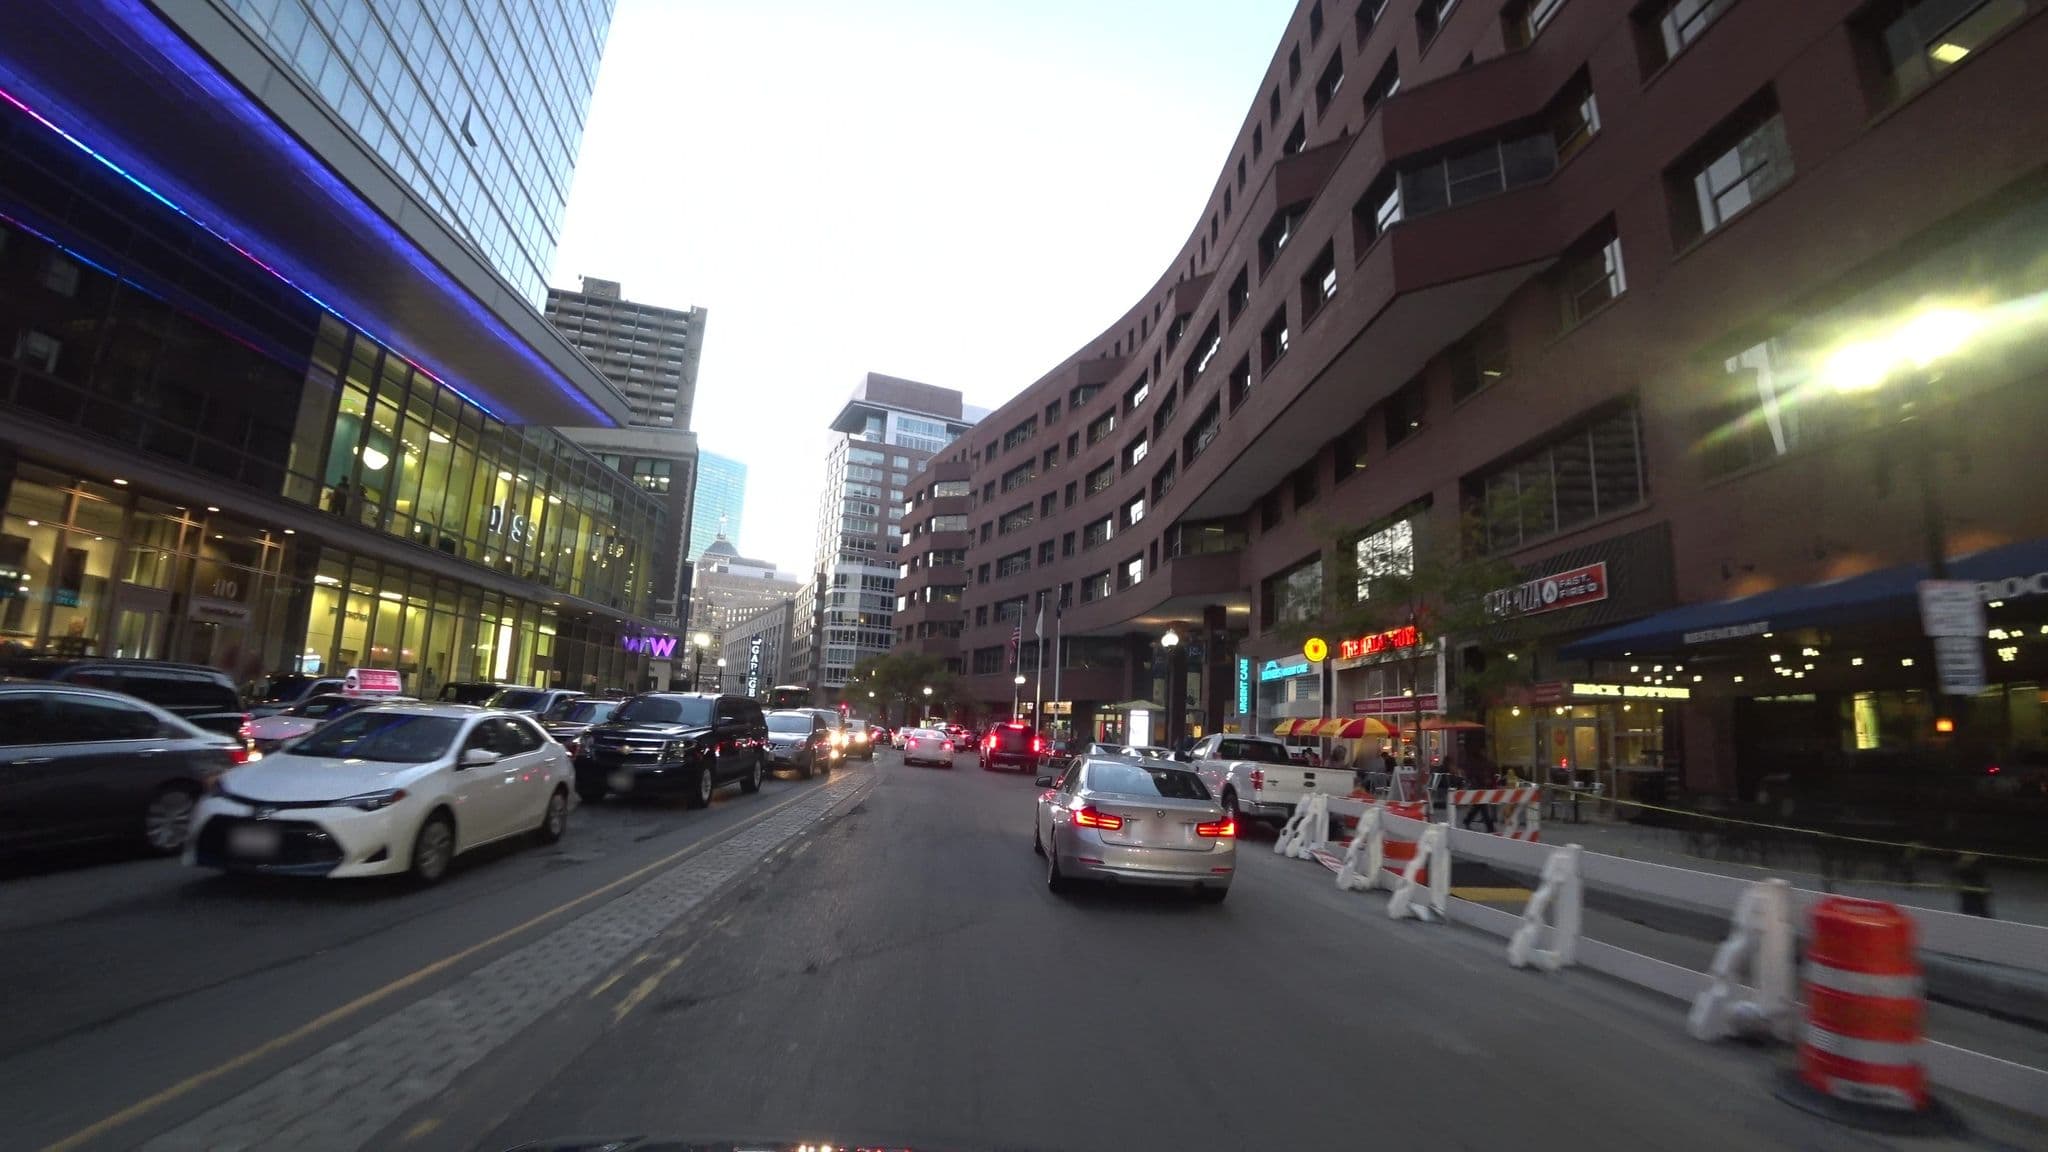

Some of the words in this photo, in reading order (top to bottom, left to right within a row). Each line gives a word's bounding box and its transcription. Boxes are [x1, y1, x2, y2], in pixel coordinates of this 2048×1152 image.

[1360, 632, 1391, 656] HALA
[748, 645, 760, 697] GARGE
[1240, 659, 1248, 680] CARE
[1240, 681, 1248, 714] URGENT
